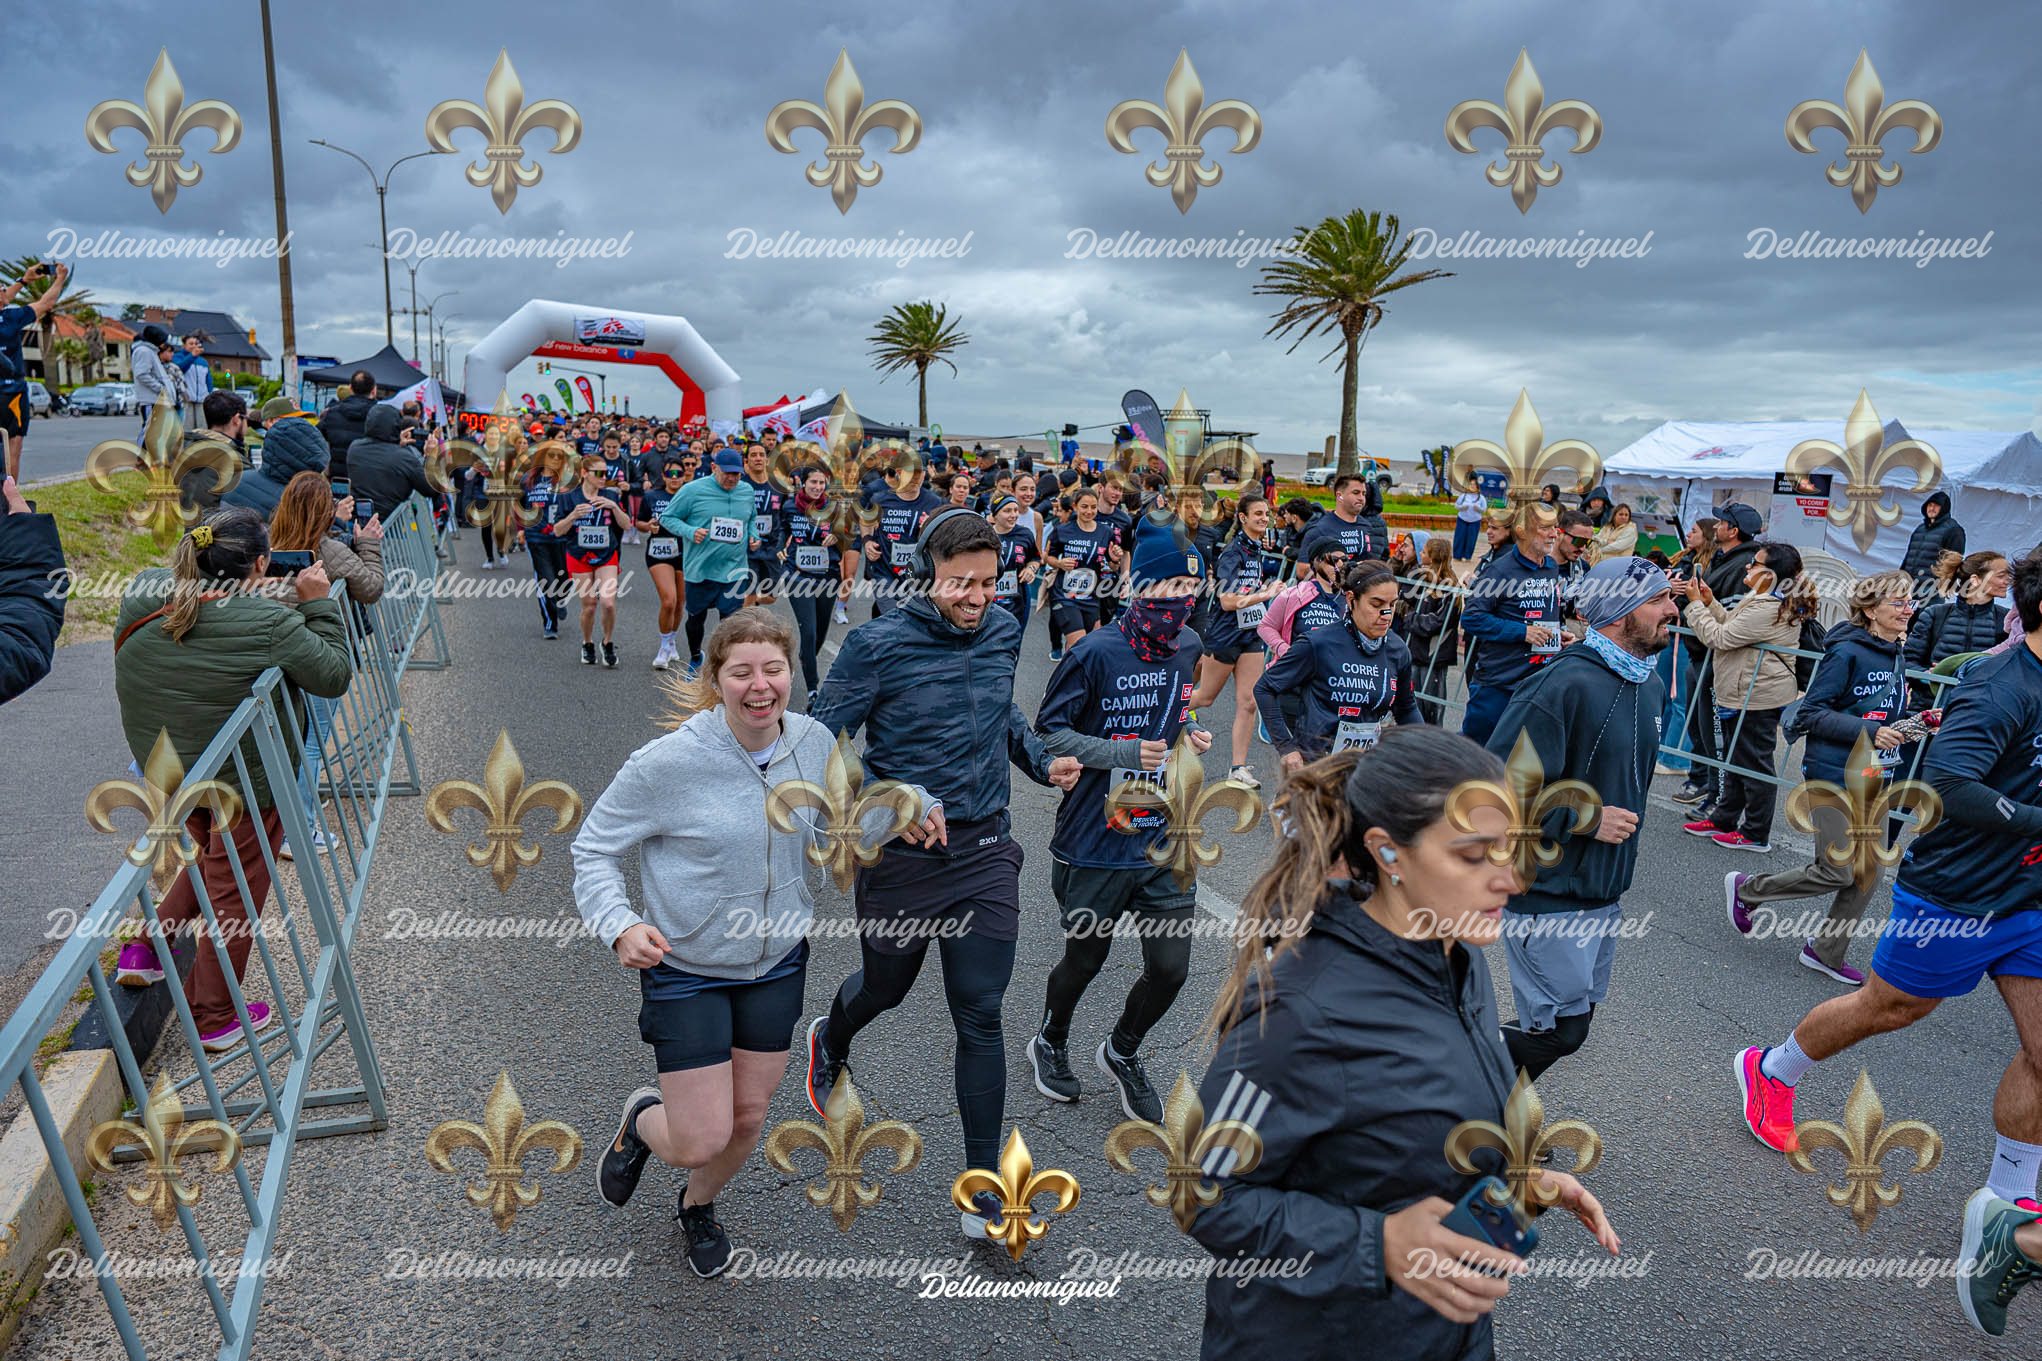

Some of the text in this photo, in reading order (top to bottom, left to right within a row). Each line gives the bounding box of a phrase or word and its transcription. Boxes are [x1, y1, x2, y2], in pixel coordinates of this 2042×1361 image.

[573, 343, 609, 354] balance
[715, 526, 738, 539] 2399
[800, 555, 821, 566] 2301
[1519, 599, 1546, 609] AYUDÁ
[1243, 609, 1263, 624] 2199
[1342, 662, 1379, 677] CORRÉ
[1116, 669, 1167, 691] CORRÉ
[1328, 676, 1376, 691] CAMINÁ
[1101, 690, 1159, 712] CAMINÁ
[1330, 691, 1370, 705] AYUDÁ
[1103, 711, 1150, 731] AYUDÁ
[978, 835, 998, 846] 2XU
